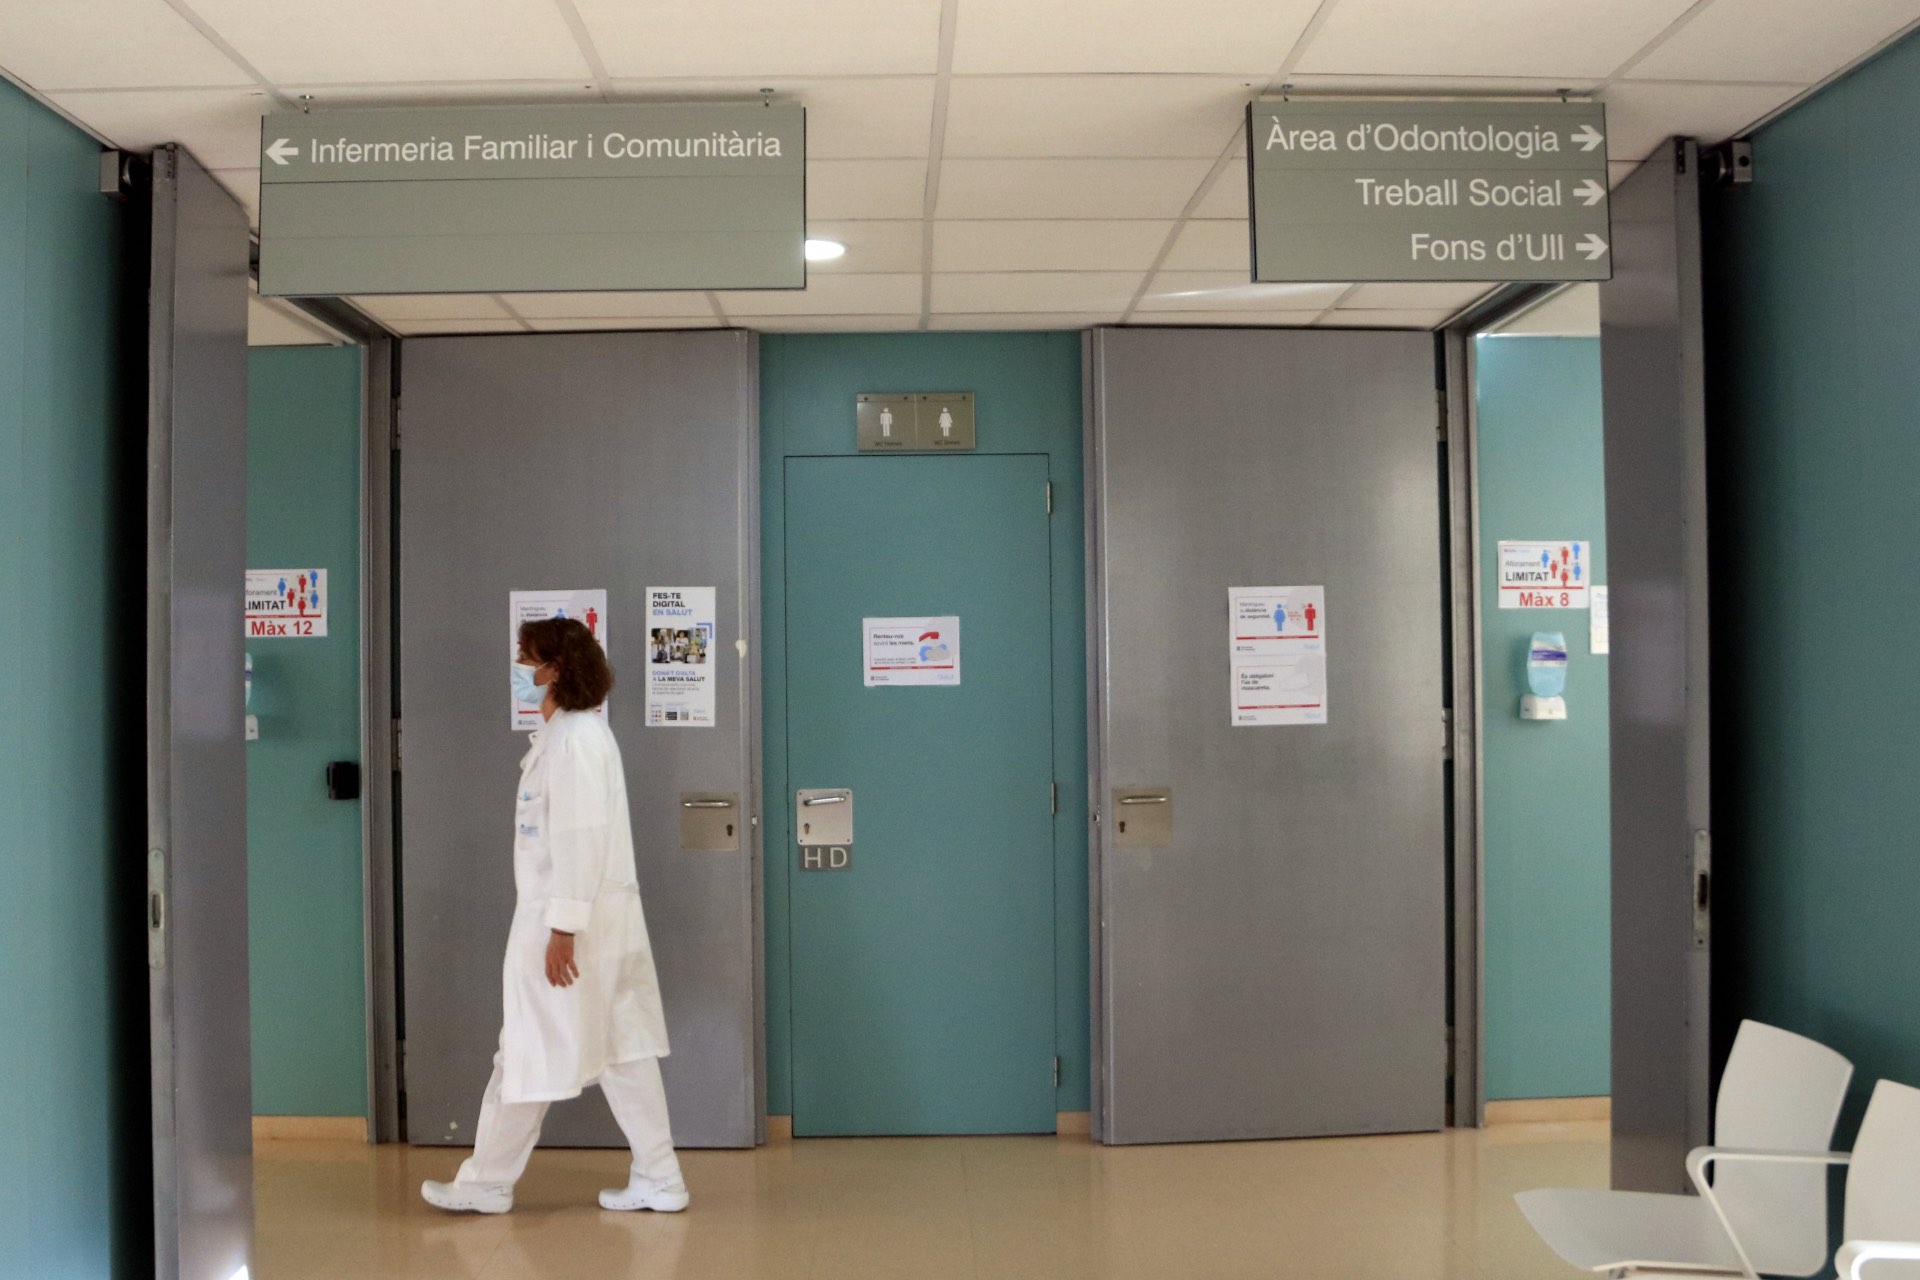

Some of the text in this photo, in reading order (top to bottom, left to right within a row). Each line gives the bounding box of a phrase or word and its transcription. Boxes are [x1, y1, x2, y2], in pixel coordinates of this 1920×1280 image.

[1266, 116, 1338, 151] Àrea
[310, 131, 782, 164] Infermeria Familiar i Comunitària
[1355, 178, 1562, 206] Treball Social
[1411, 233, 1487, 261] Fons
[1505, 560, 1541, 568] Aforament
[1505, 571, 1550, 582] LIMITAT
[652, 592, 682, 600] FES-TE
[1519, 591, 1570, 607] Màx 8
[245, 600, 286, 611] IMITAT
[652, 600, 686, 608] DIGITAL
[652, 608, 693, 616] EN SALUT
[251, 620, 313, 636] Màx 12
